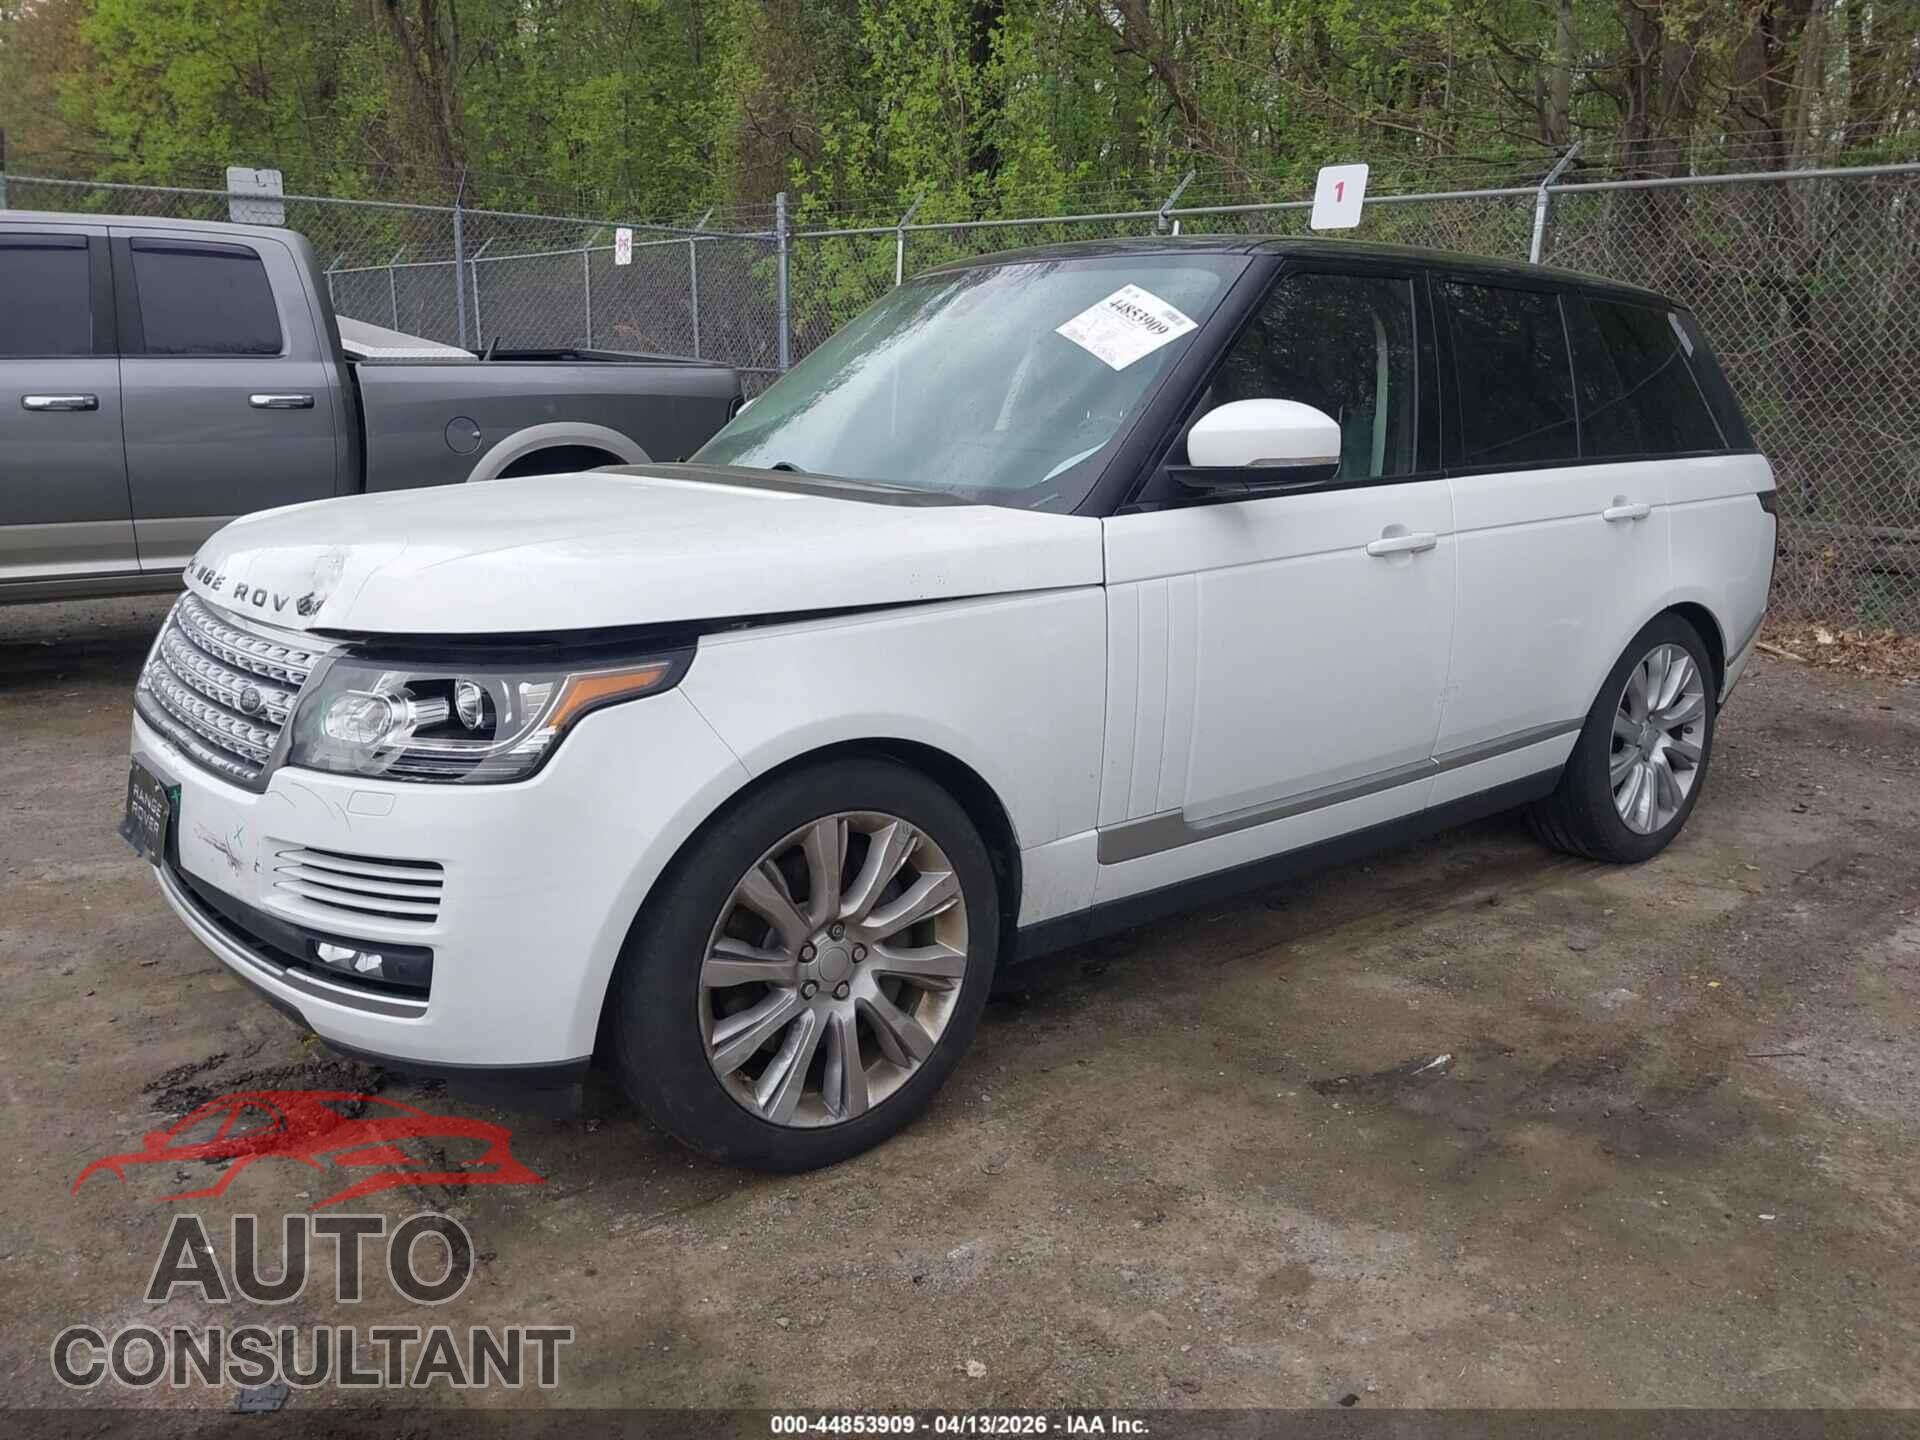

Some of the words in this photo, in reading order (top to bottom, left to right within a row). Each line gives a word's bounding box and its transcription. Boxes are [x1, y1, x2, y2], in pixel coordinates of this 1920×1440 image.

[1334, 181, 1344, 203] 1
[1109, 299, 1169, 335] 44853909
[131, 800, 160, 832] ROVER
[133, 783, 162, 818] RANGE
